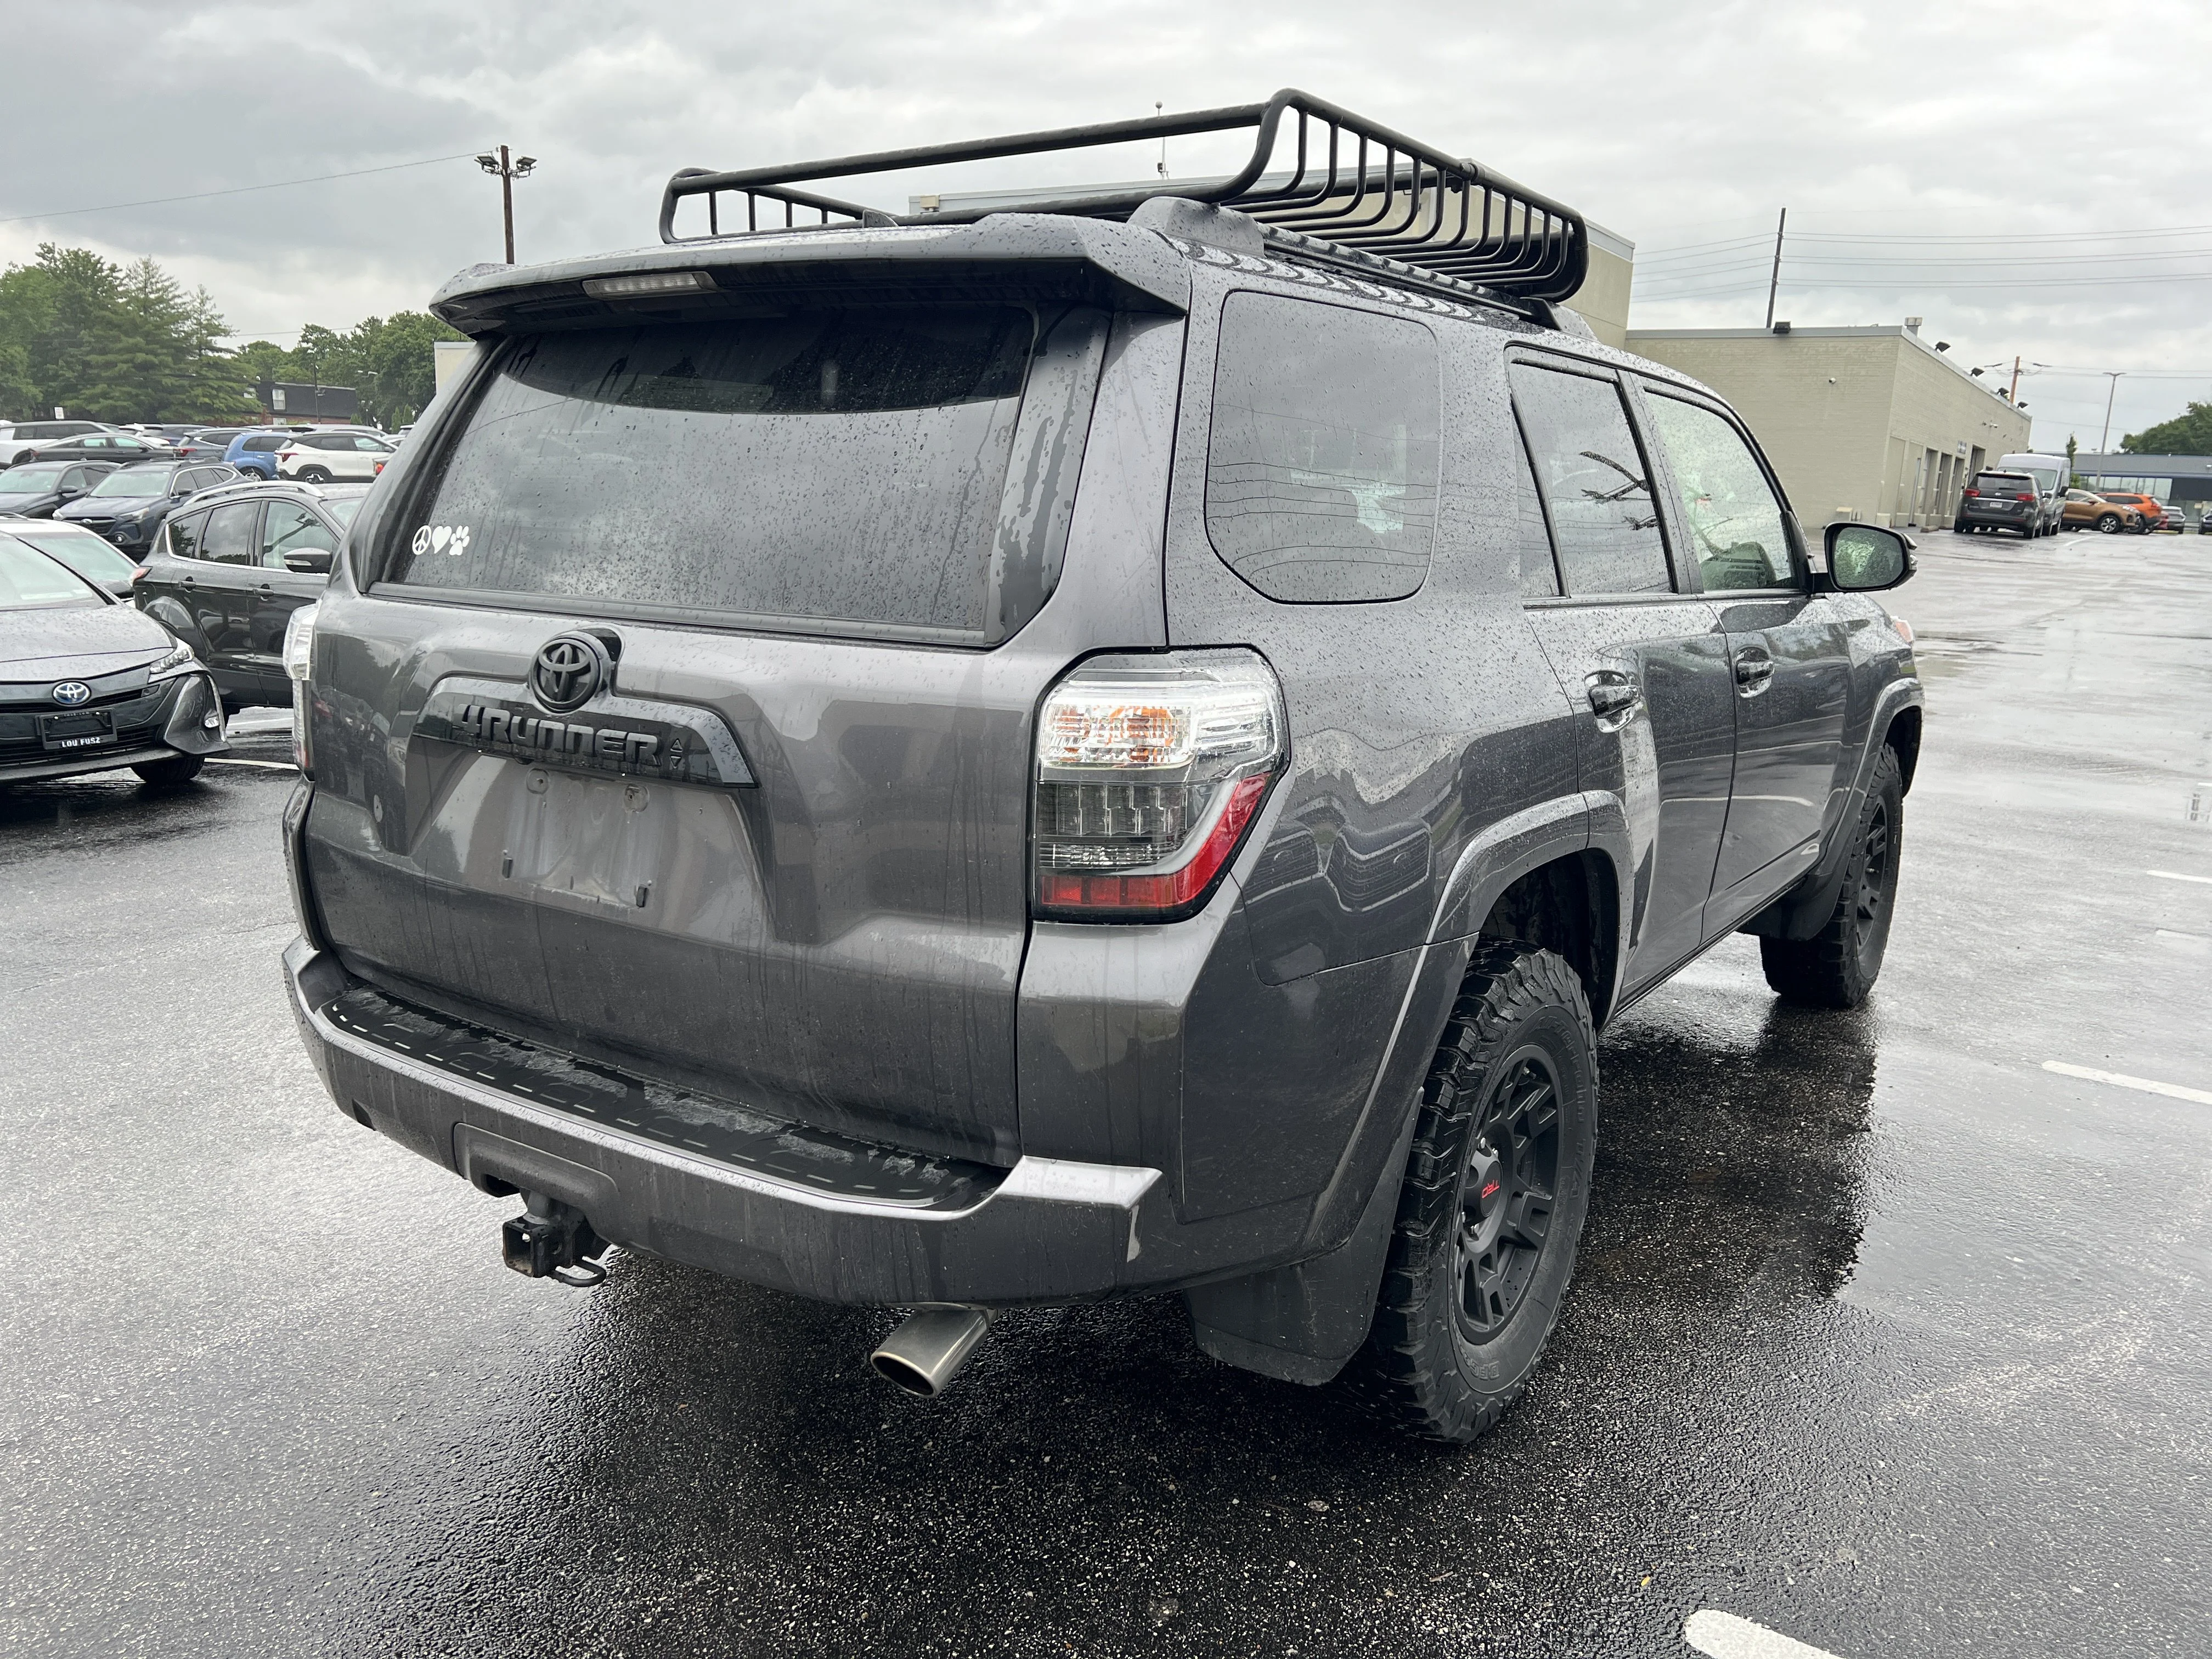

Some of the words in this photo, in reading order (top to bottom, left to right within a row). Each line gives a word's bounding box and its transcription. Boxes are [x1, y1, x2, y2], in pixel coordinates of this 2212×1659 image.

[62, 740, 77, 748] LOU
[81, 737, 100, 746] FUSZ
[455, 703, 661, 766] 4RUNNER
[1482, 1180, 1500, 1199] TRD
